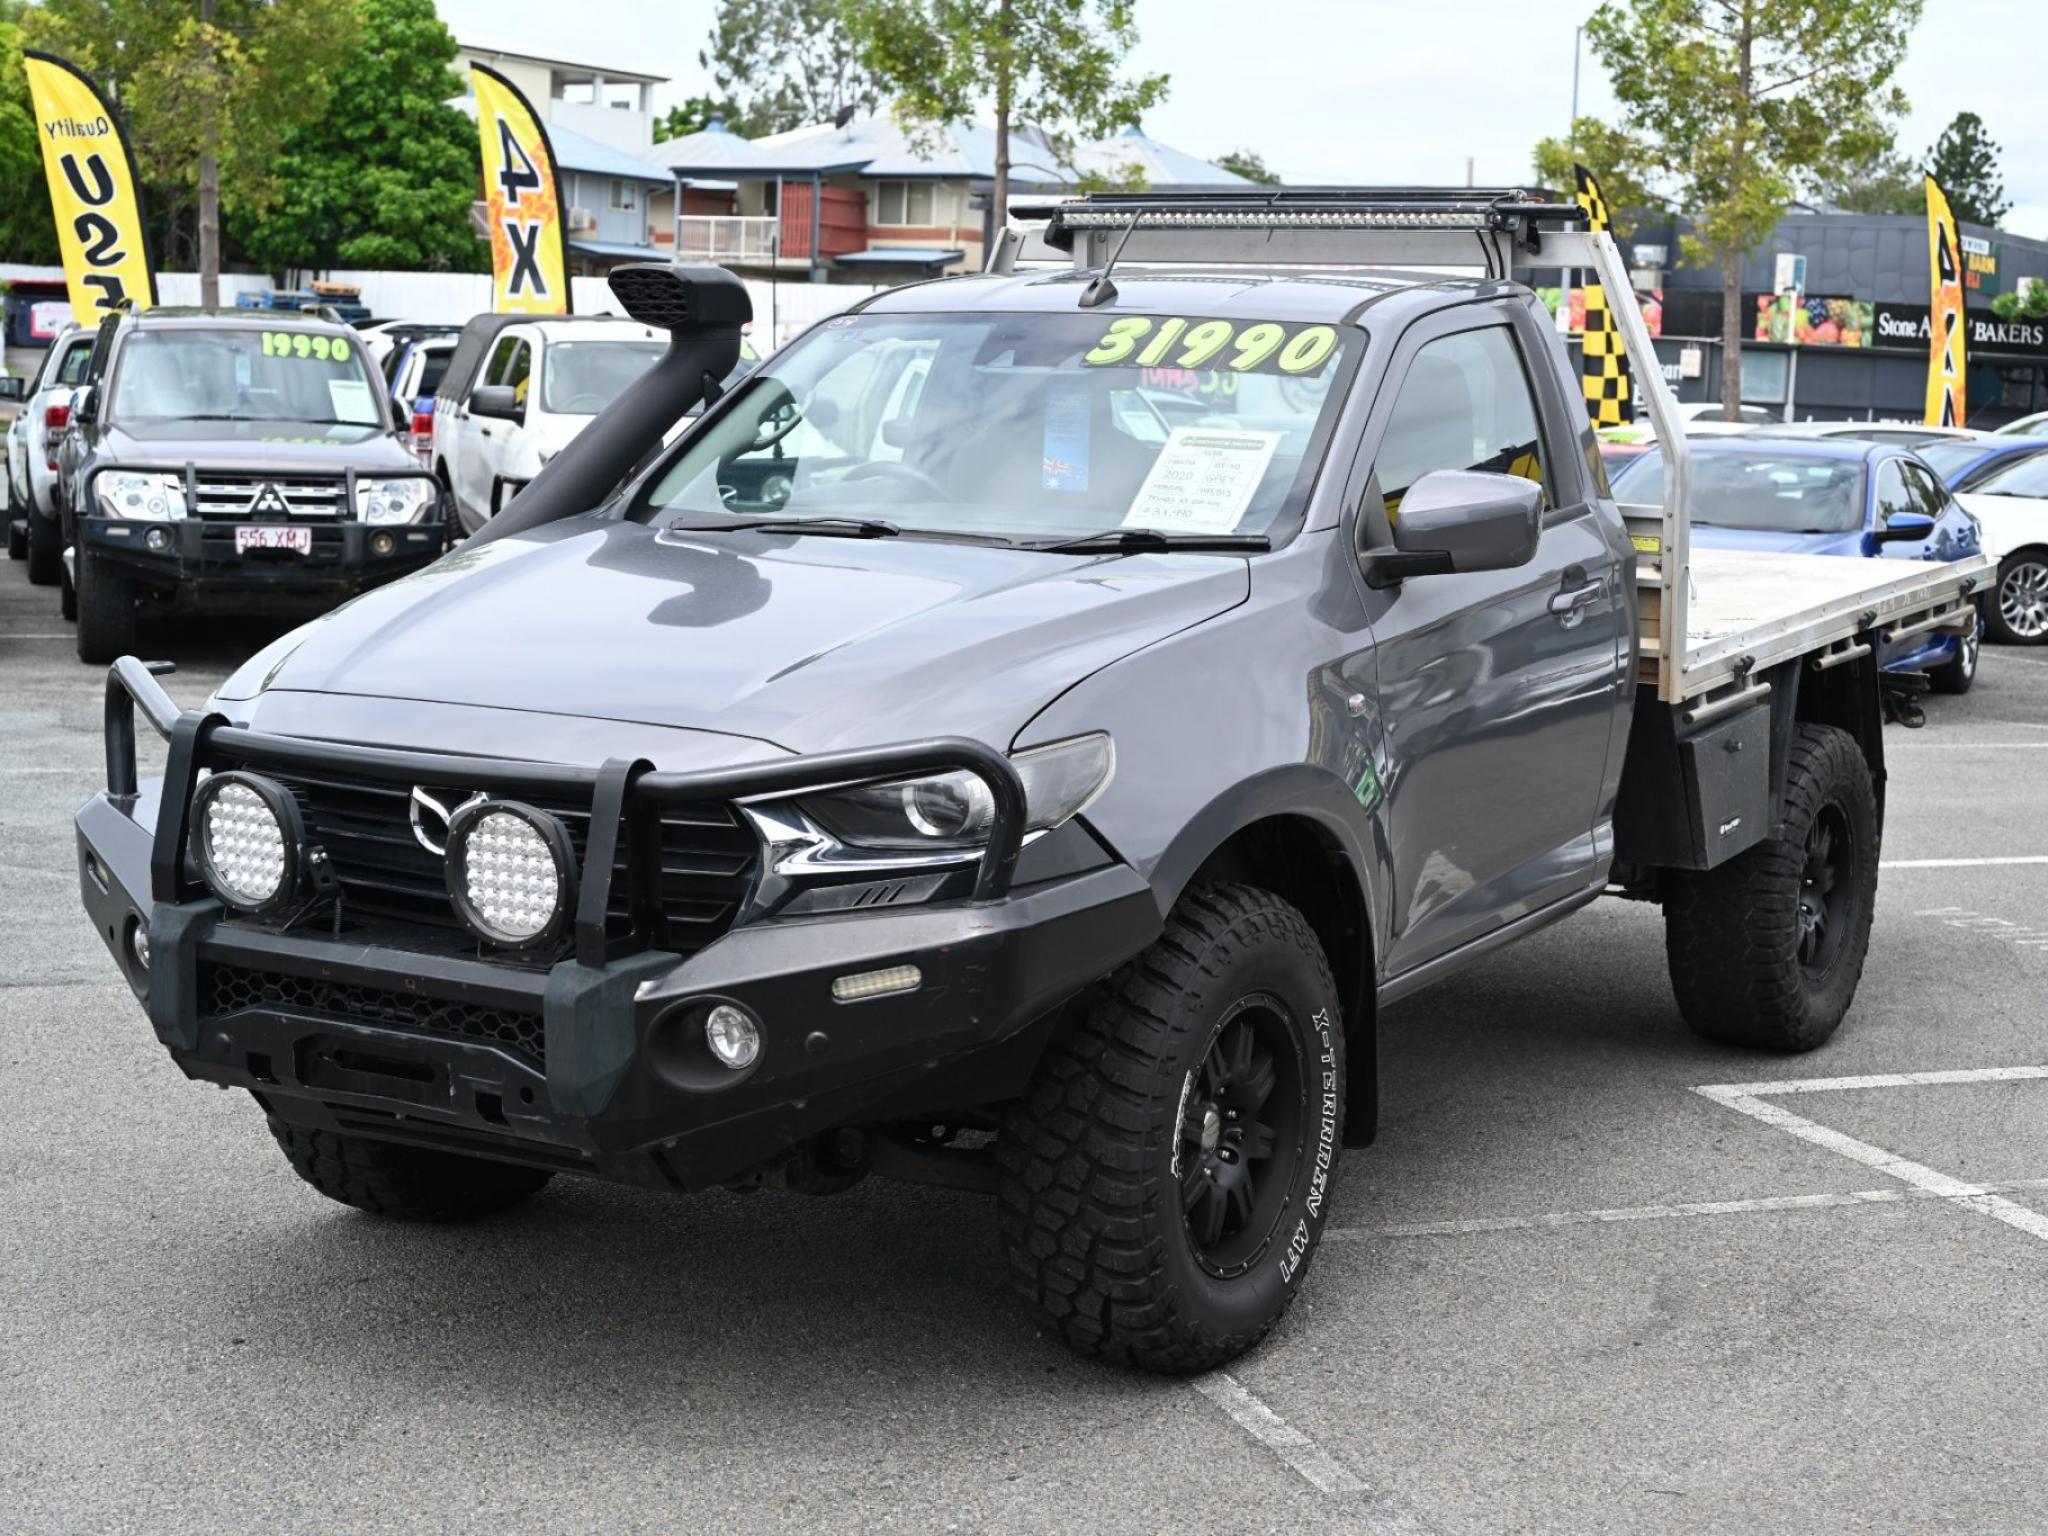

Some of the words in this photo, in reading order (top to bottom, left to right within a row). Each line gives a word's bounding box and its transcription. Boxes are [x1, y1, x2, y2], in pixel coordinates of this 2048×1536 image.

[1878, 312, 1918, 337] Stone
[1974, 322, 2044, 345] BAKERS
[262, 331, 351, 362] 19990
[1084, 317, 1338, 373] 31990
[239, 530, 268, 546] 556
[273, 530, 308, 548] XMJ
